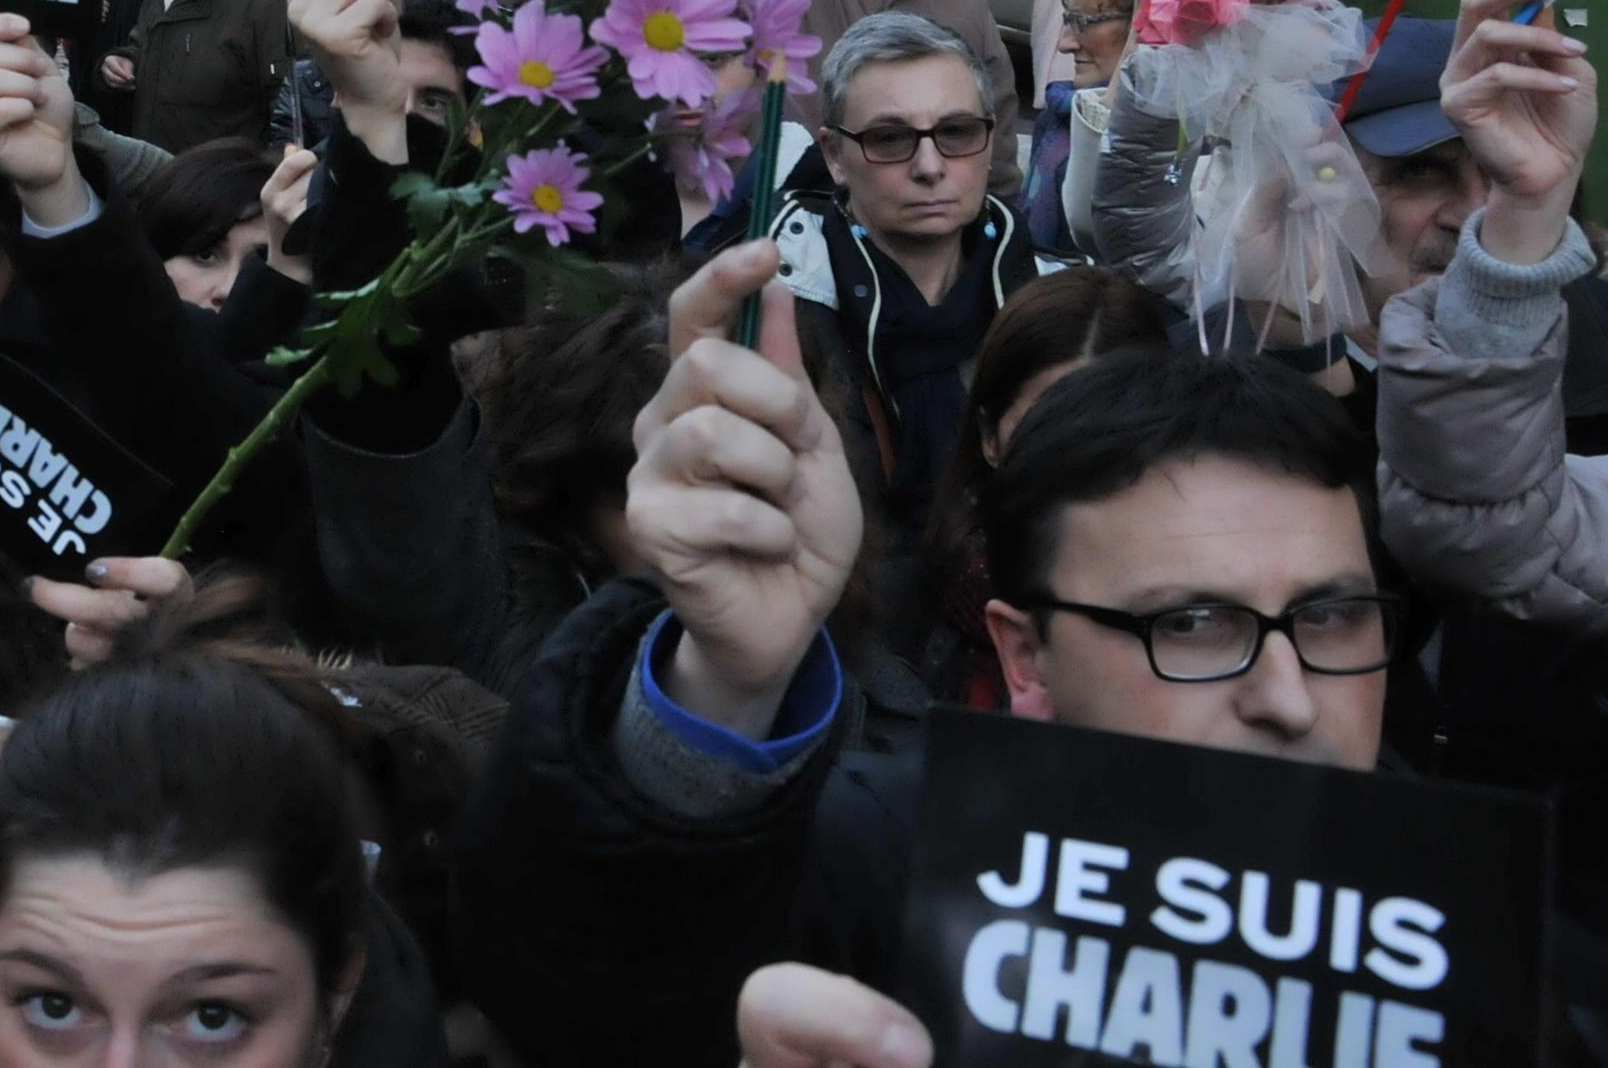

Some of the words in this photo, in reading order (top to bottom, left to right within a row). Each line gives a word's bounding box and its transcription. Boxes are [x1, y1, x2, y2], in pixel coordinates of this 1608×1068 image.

[27, 499, 86, 556] JE
[976, 831, 1129, 927] JE
[1149, 857, 1450, 990] SUIS
[963, 919, 1446, 1068] CHARLIE
